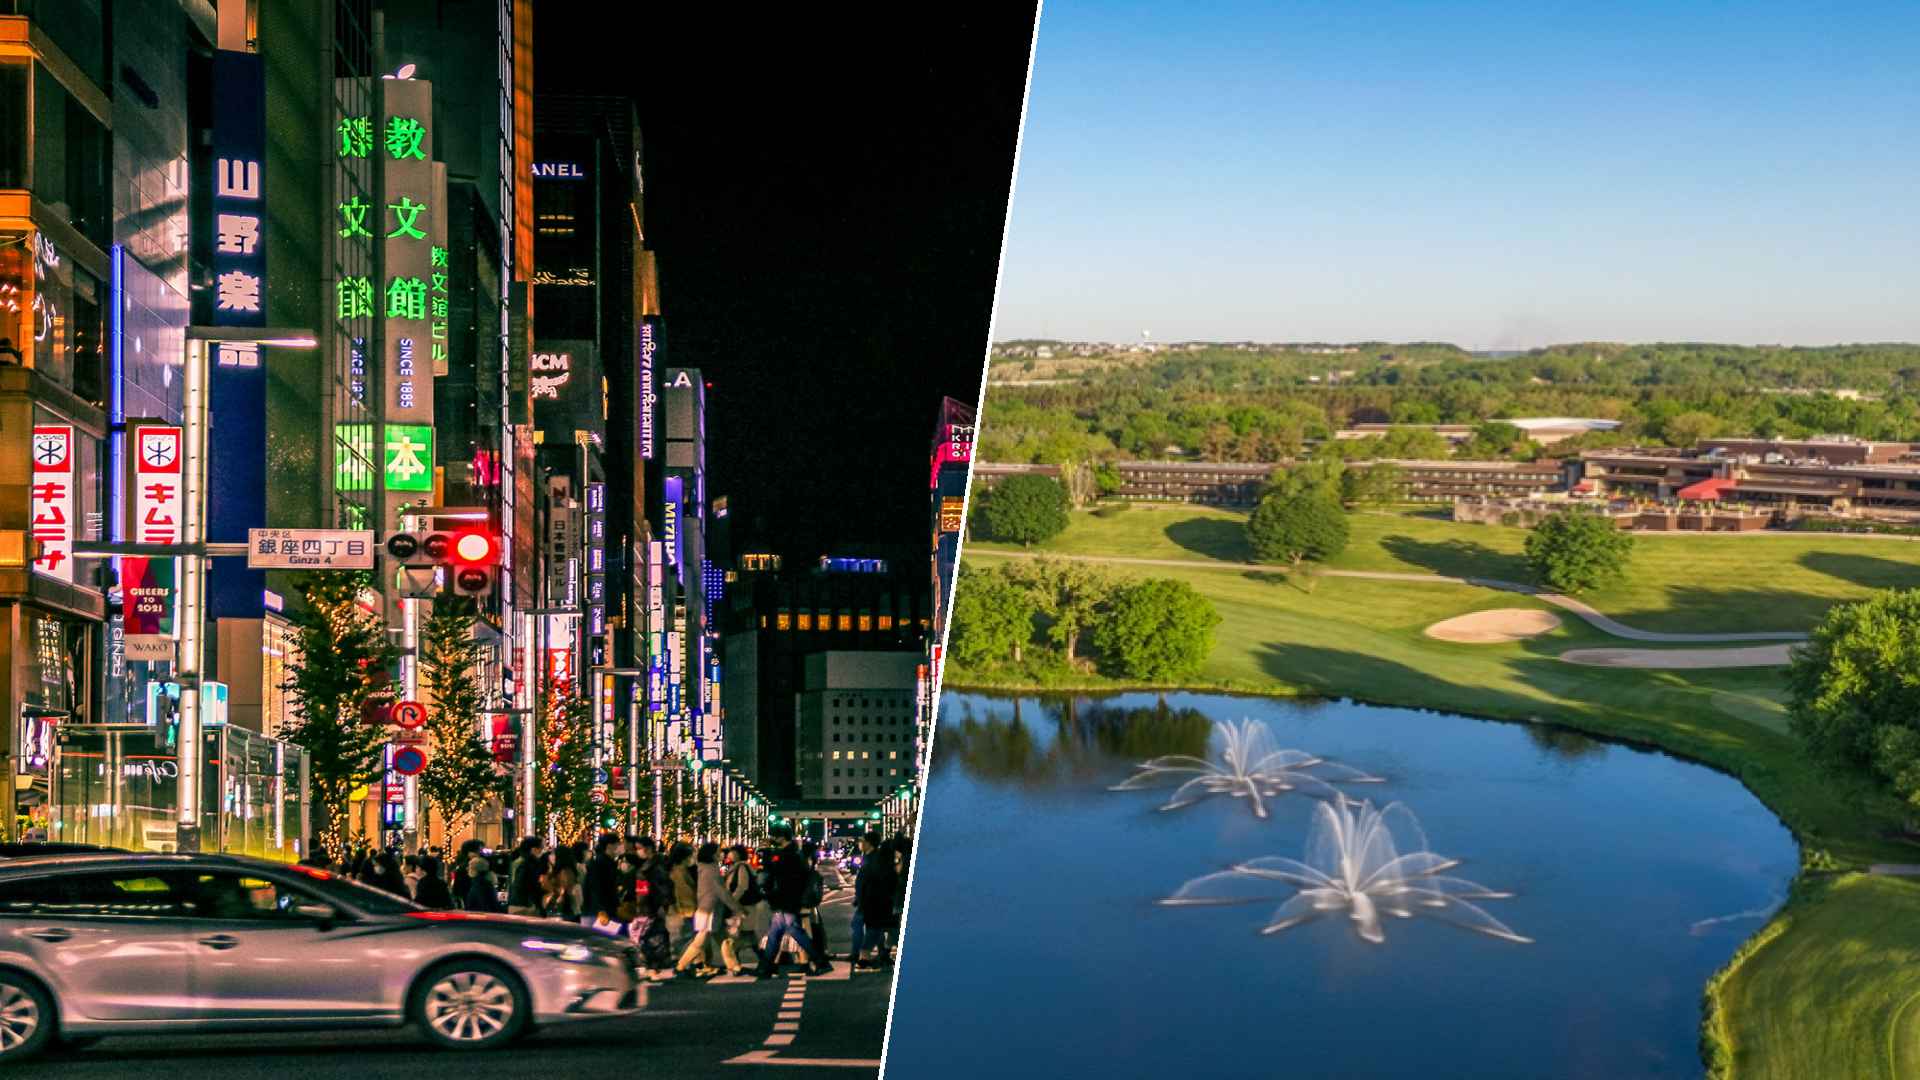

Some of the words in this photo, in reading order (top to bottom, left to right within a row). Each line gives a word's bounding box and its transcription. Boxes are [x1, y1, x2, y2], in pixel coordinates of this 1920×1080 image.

[385, 115, 427, 320] 教文館
[400, 338, 413, 376] SINCE
[400, 382, 413, 408] 1885
[387, 436, 426, 480] 本
[258, 530, 291, 538] 中央区
[258, 539, 364, 555] 銀座四丁目
[289, 556, 320, 564] Ginza
[324, 556, 331, 564] 4
[130, 587, 169, 596] CHEERS
[134, 643, 168, 653] WAKO
